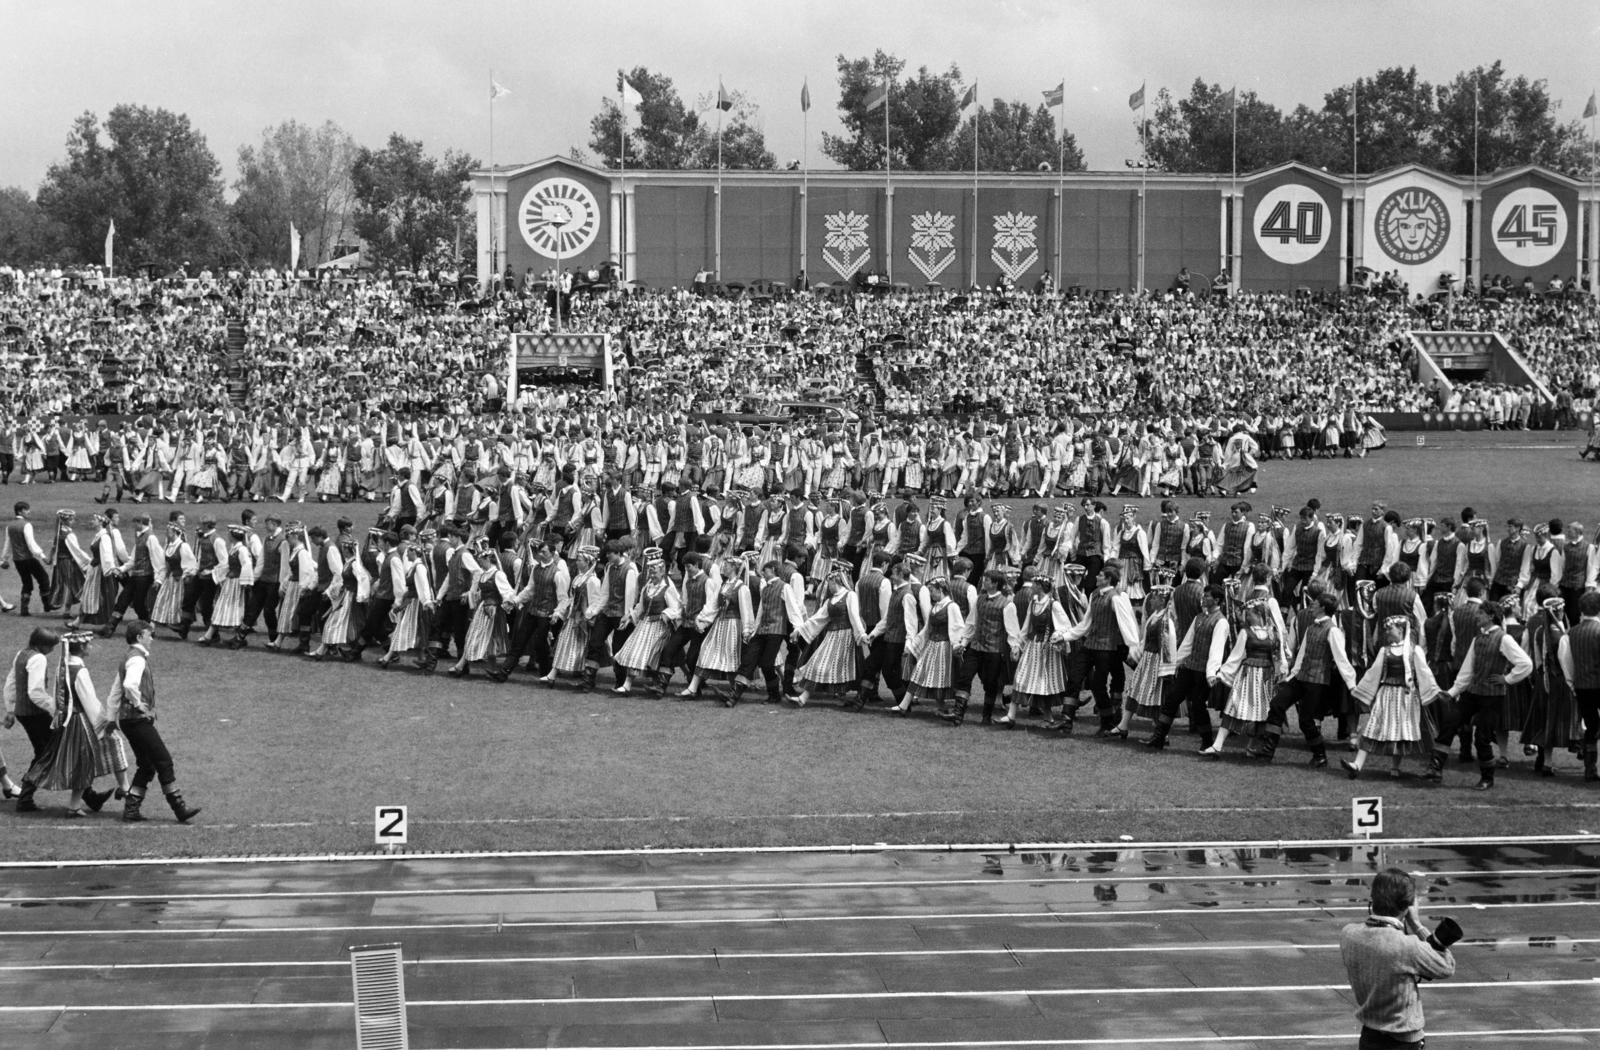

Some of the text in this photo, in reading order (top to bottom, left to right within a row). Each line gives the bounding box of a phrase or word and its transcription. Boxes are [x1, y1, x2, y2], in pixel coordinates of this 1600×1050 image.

[1396, 191, 1431, 210] XLV
[1260, 200, 1323, 244] 40
[1497, 204, 1558, 248] 45
[1399, 251, 1427, 261] 1985
[380, 809, 403, 836] 2
[1357, 799, 1379, 826] 3
